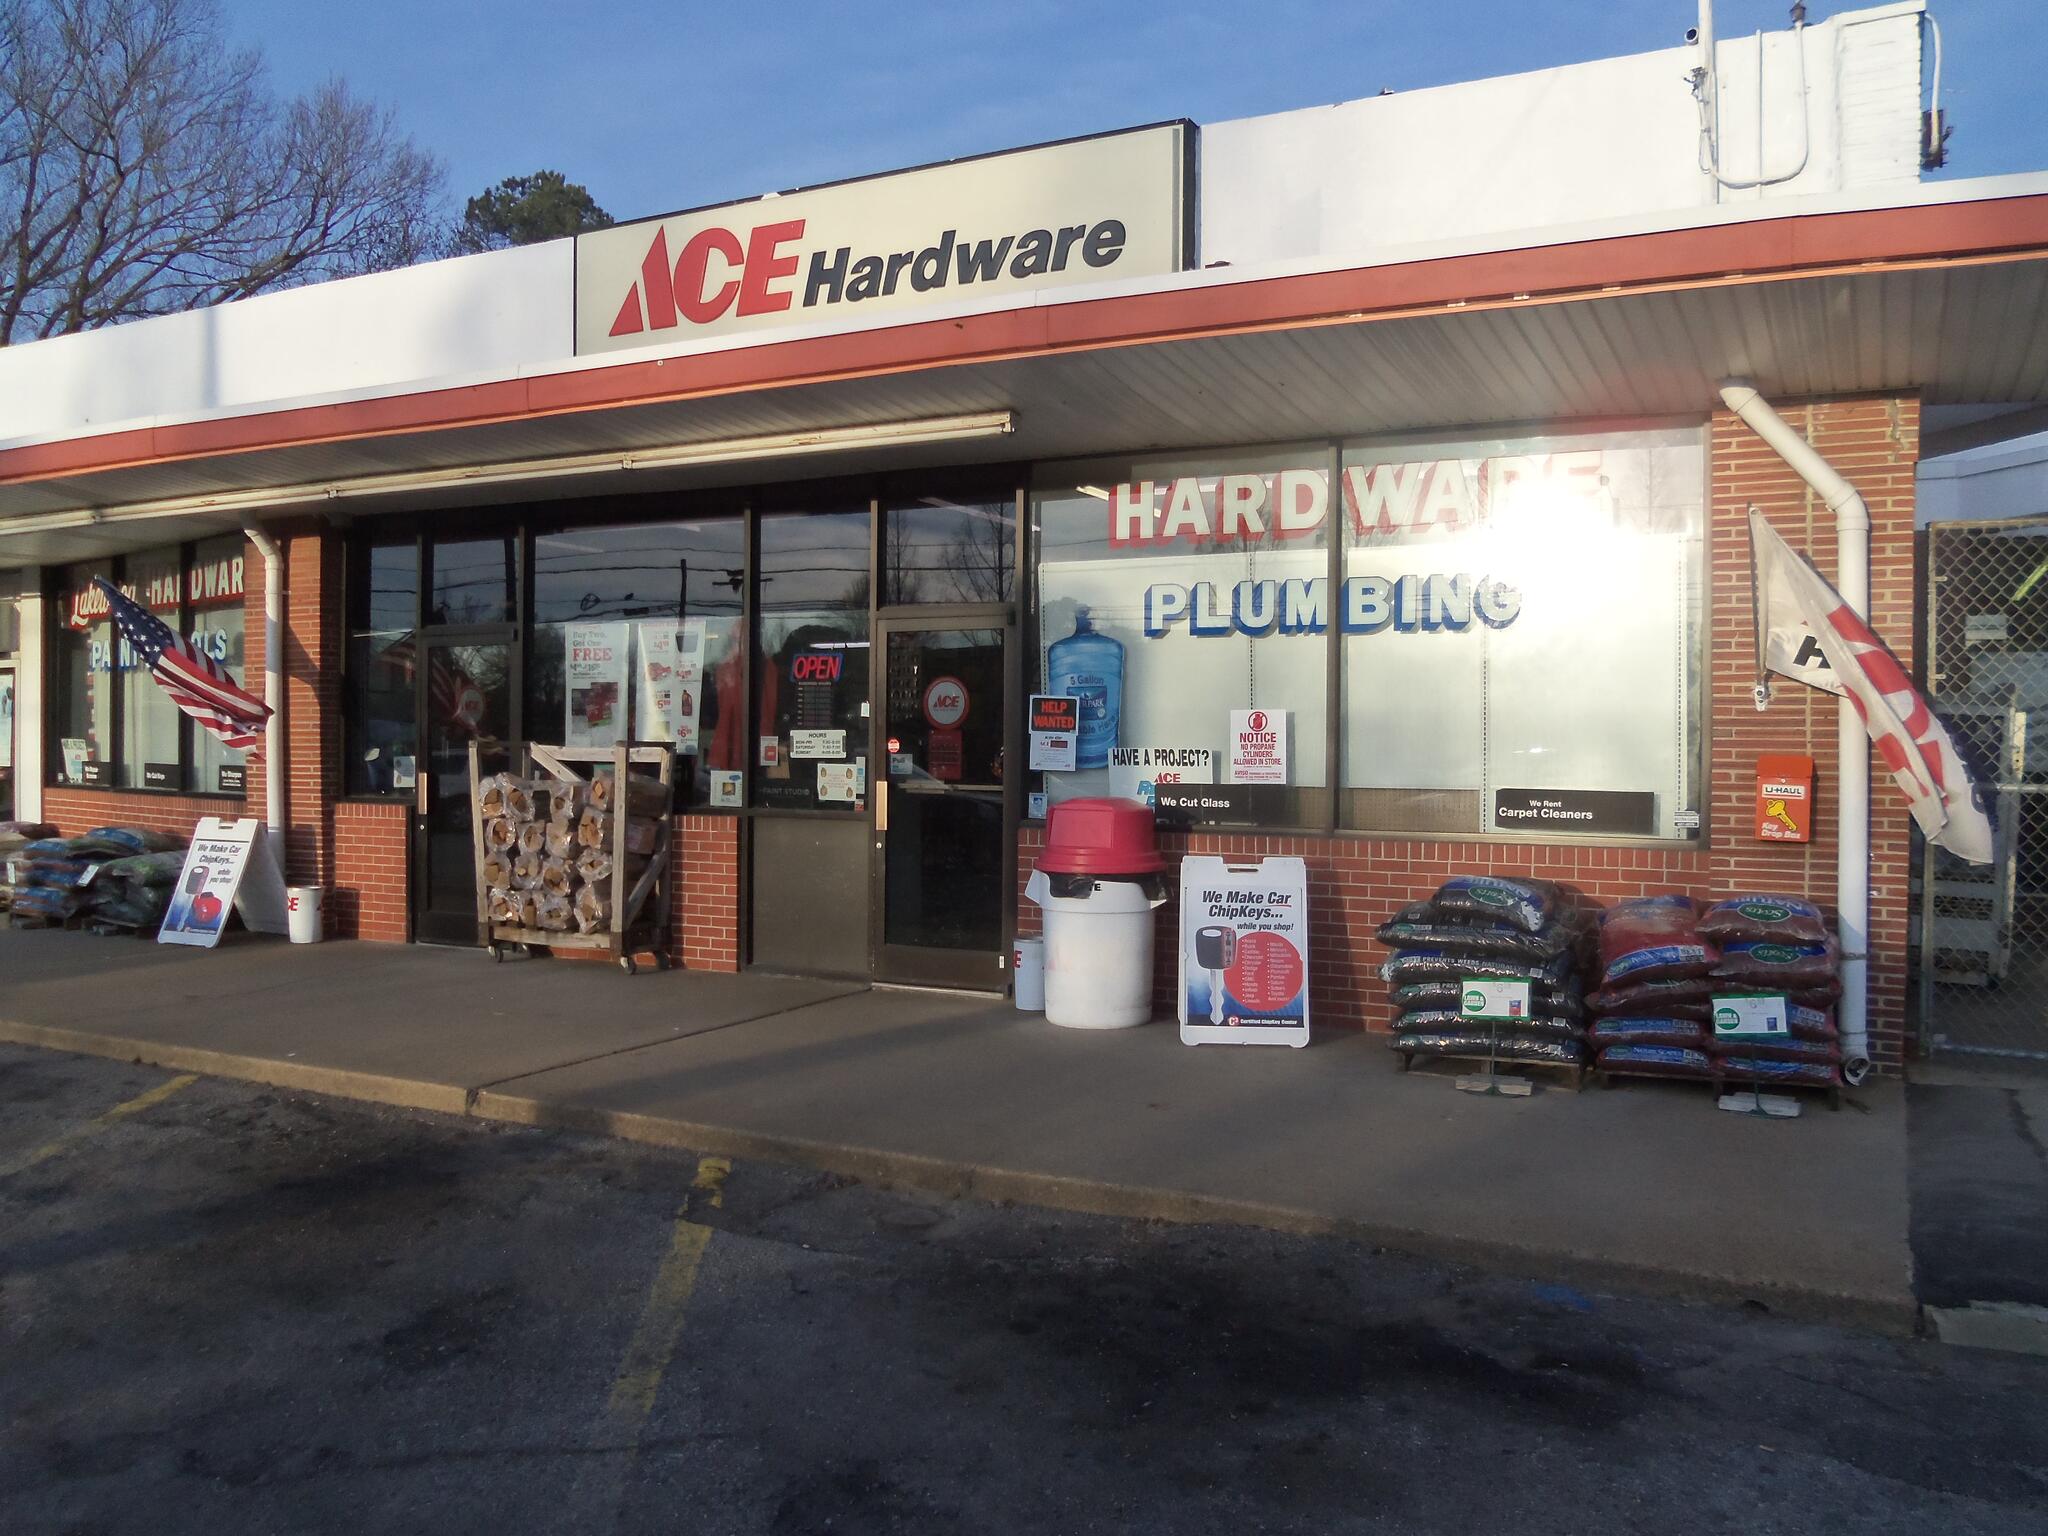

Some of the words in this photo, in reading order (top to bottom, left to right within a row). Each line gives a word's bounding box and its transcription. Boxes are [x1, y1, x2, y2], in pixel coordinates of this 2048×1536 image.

[608, 219, 806, 337] ACE
[803, 219, 1126, 308] Hardware
[151, 556, 244, 606] HADWAR
[1144, 575, 1521, 638] PLUMBING
[572, 647, 613, 662] FREE
[794, 656, 840, 679] OPEN
[1077, 674, 1104, 687] Gallon
[933, 695, 960, 708] ACE
[1041, 701, 1068, 713] HELP
[1033, 716, 1075, 729] WANTED
[1239, 732, 1277, 743] NOTICE
[1250, 743, 1276, 751] PROPANE
[1112, 748, 1140, 766] HAVE
[1144, 748, 1151, 766] A
[1154, 748, 1210, 767] PROJECT?
[1242, 750, 1273, 758] CYLINDERS
[1233, 758, 1257, 766] ALLOWED
[1154, 772, 1181, 783] ACE
[1765, 786, 1802, 795] U-HAUL
[1160, 797, 1177, 807] We
[1179, 797, 1198, 808] Cut
[1200, 798, 1230, 808] Glass
[1543, 800, 1562, 808] Rent
[1498, 807, 1538, 820] Carpet
[1540, 808, 1593, 820] Cleaners
[1761, 822, 1779, 831] Key
[1761, 829, 1783, 839] Drop
[1784, 831, 1801, 839] Box
[1202, 890, 1222, 903] We
[1226, 891, 1264, 904] Make
[1267, 892, 1292, 904] Car
[1745, 906, 1784, 918] Scotts
[1237, 922, 1257, 930] while
[1273, 923, 1294, 932] shop!
[1457, 959, 1480, 967] WEEDS
